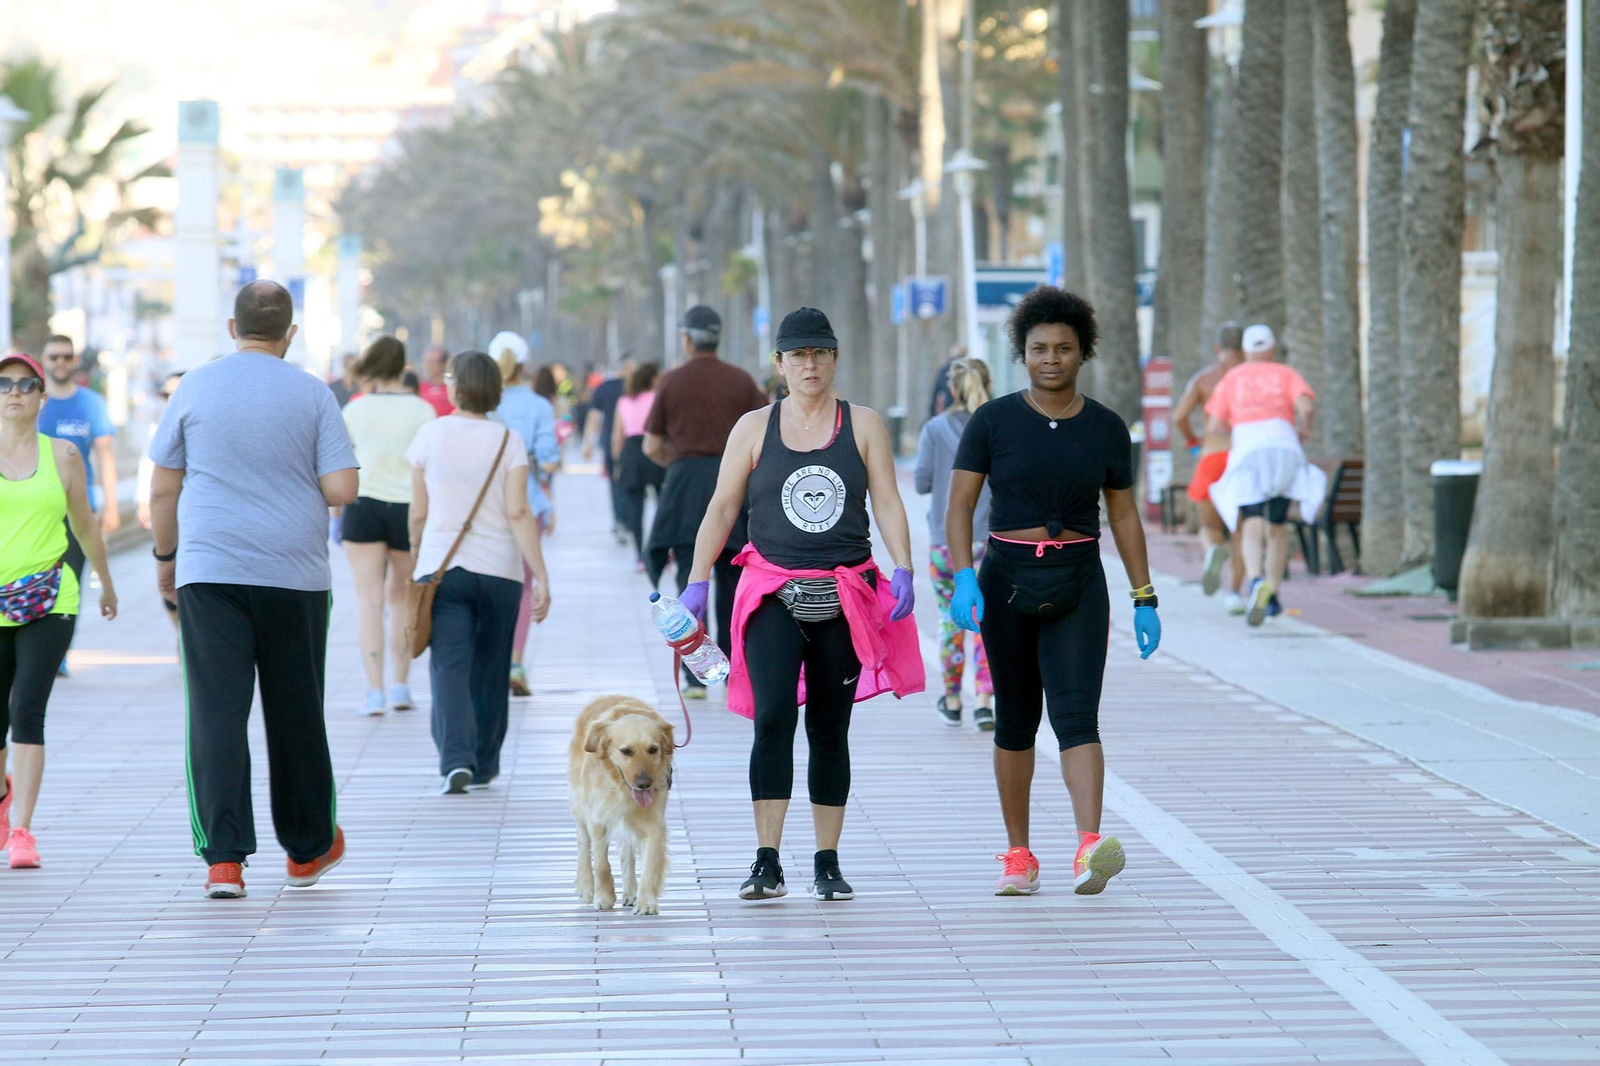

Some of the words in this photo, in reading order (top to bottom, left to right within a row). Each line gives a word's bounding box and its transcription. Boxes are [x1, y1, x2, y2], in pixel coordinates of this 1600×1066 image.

[783, 480, 794, 510] THERE
[796, 467, 813, 478] ARE
[818, 467, 830, 476] NO
[832, 475, 844, 508] LIMITS
[802, 521, 830, 531] ROXY
